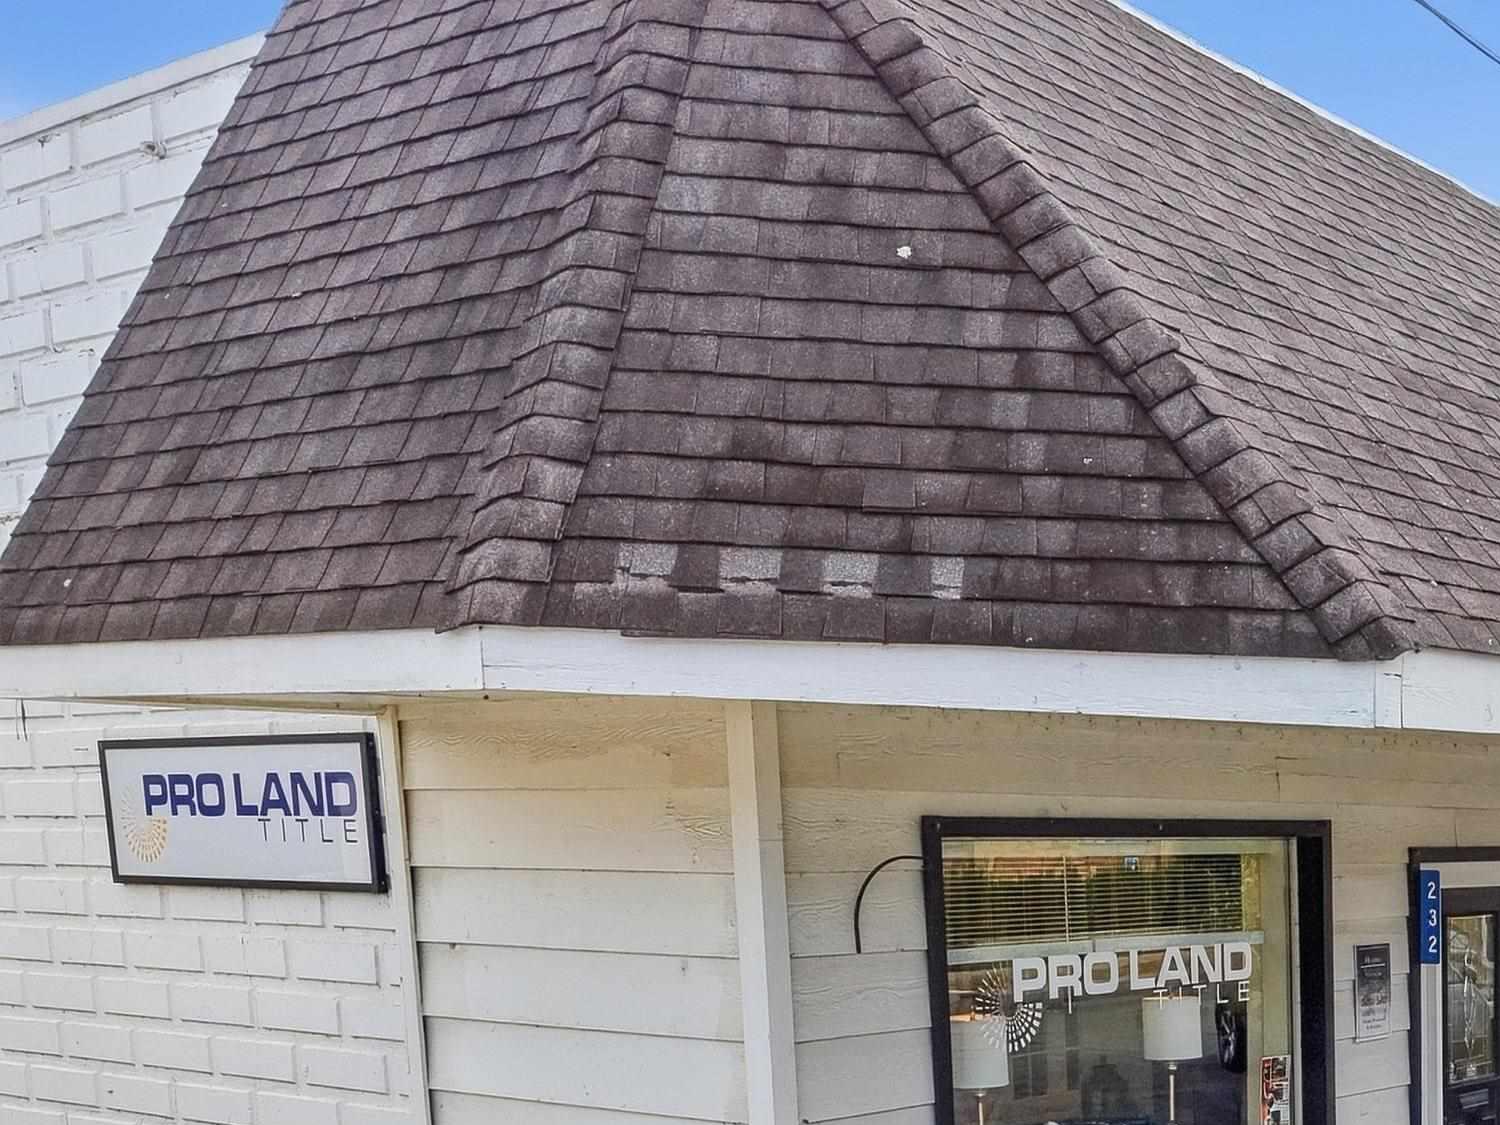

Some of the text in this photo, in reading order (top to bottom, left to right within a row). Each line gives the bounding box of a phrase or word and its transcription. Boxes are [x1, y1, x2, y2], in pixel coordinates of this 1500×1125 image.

[142, 771, 358, 817] PRO LAND
[257, 818, 358, 843] TITLE
[1427, 881, 1438, 953] 232
[1012, 942, 1252, 1003] PRO LAND
